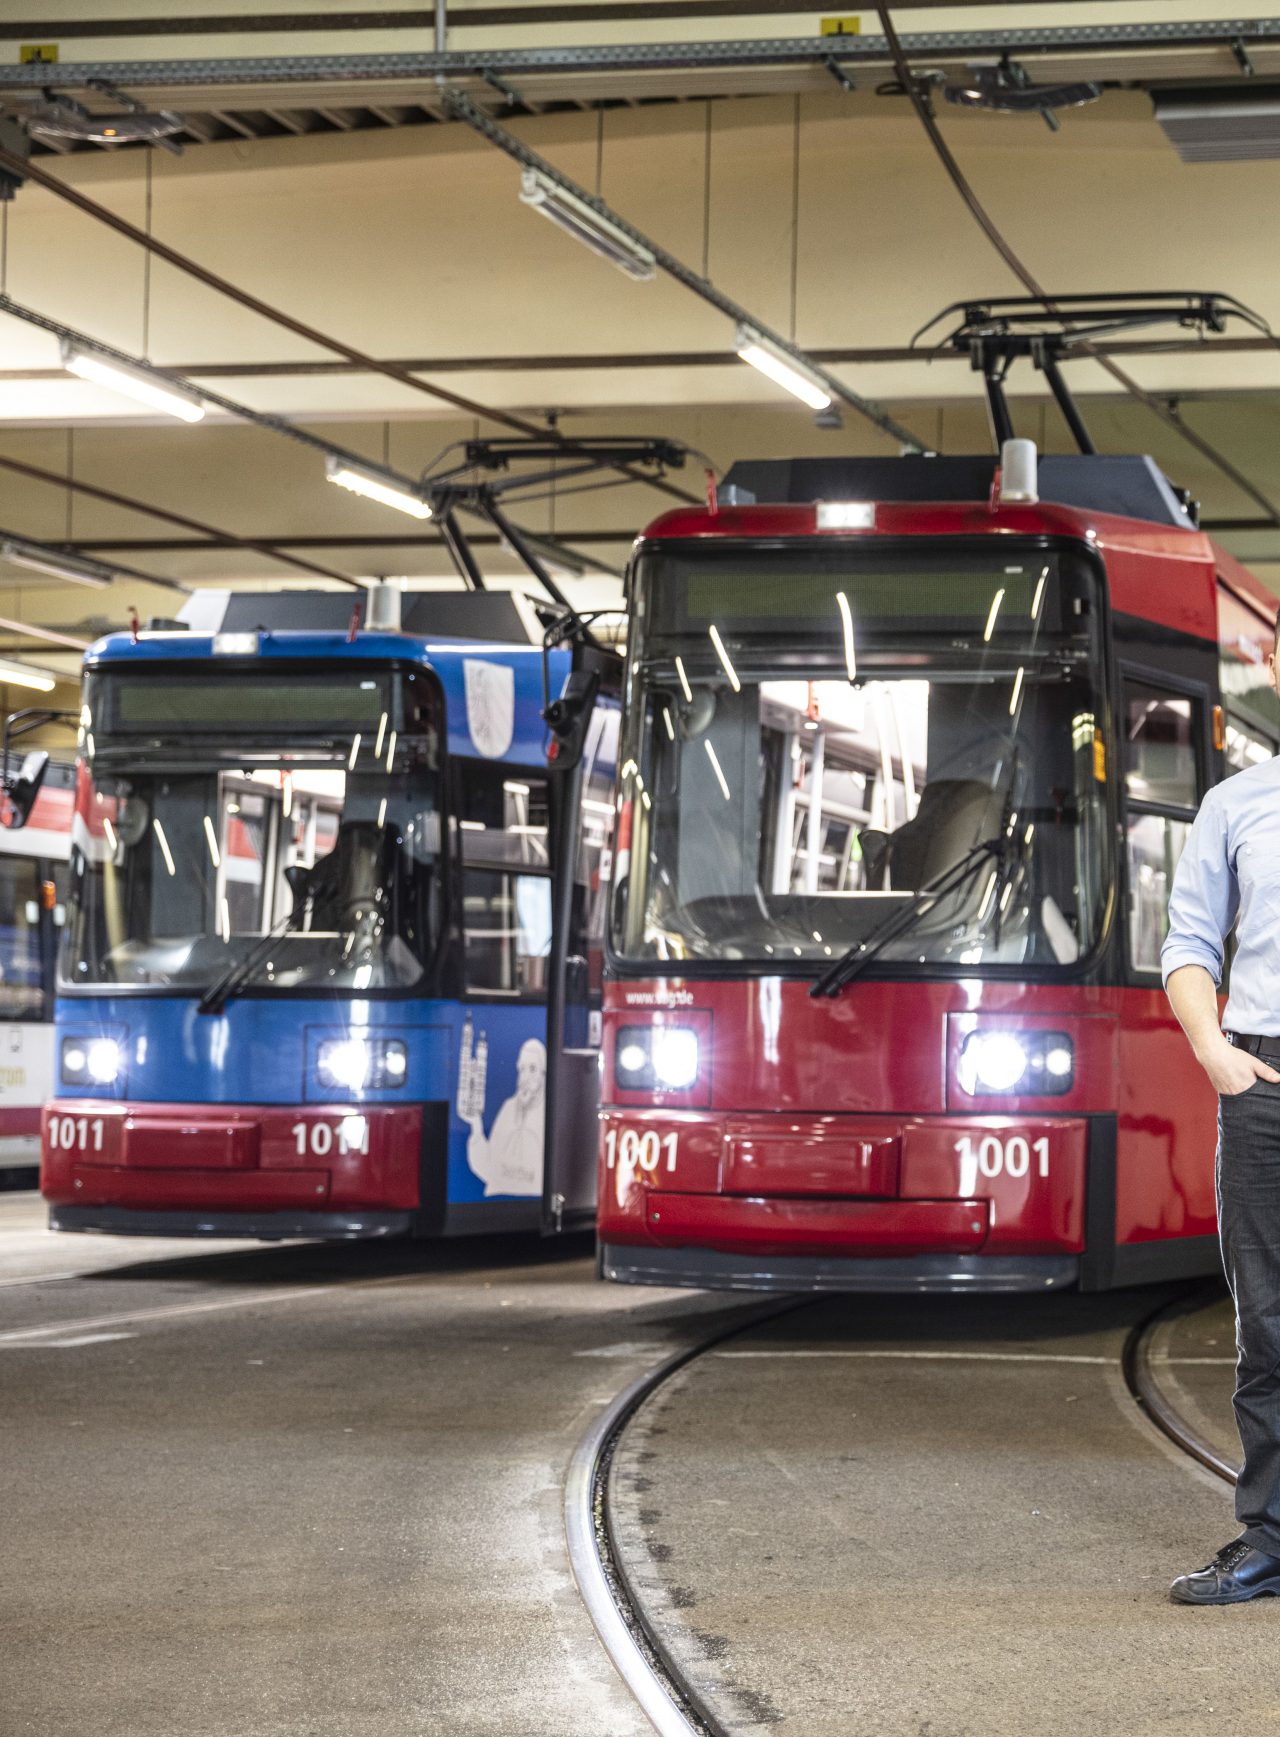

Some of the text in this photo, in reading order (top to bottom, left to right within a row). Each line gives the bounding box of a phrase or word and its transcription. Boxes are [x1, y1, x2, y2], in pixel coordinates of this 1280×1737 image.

[47, 1116, 104, 1151] 1011
[604, 1129, 679, 1172] 1001
[953, 1136, 1050, 1178] 1001
